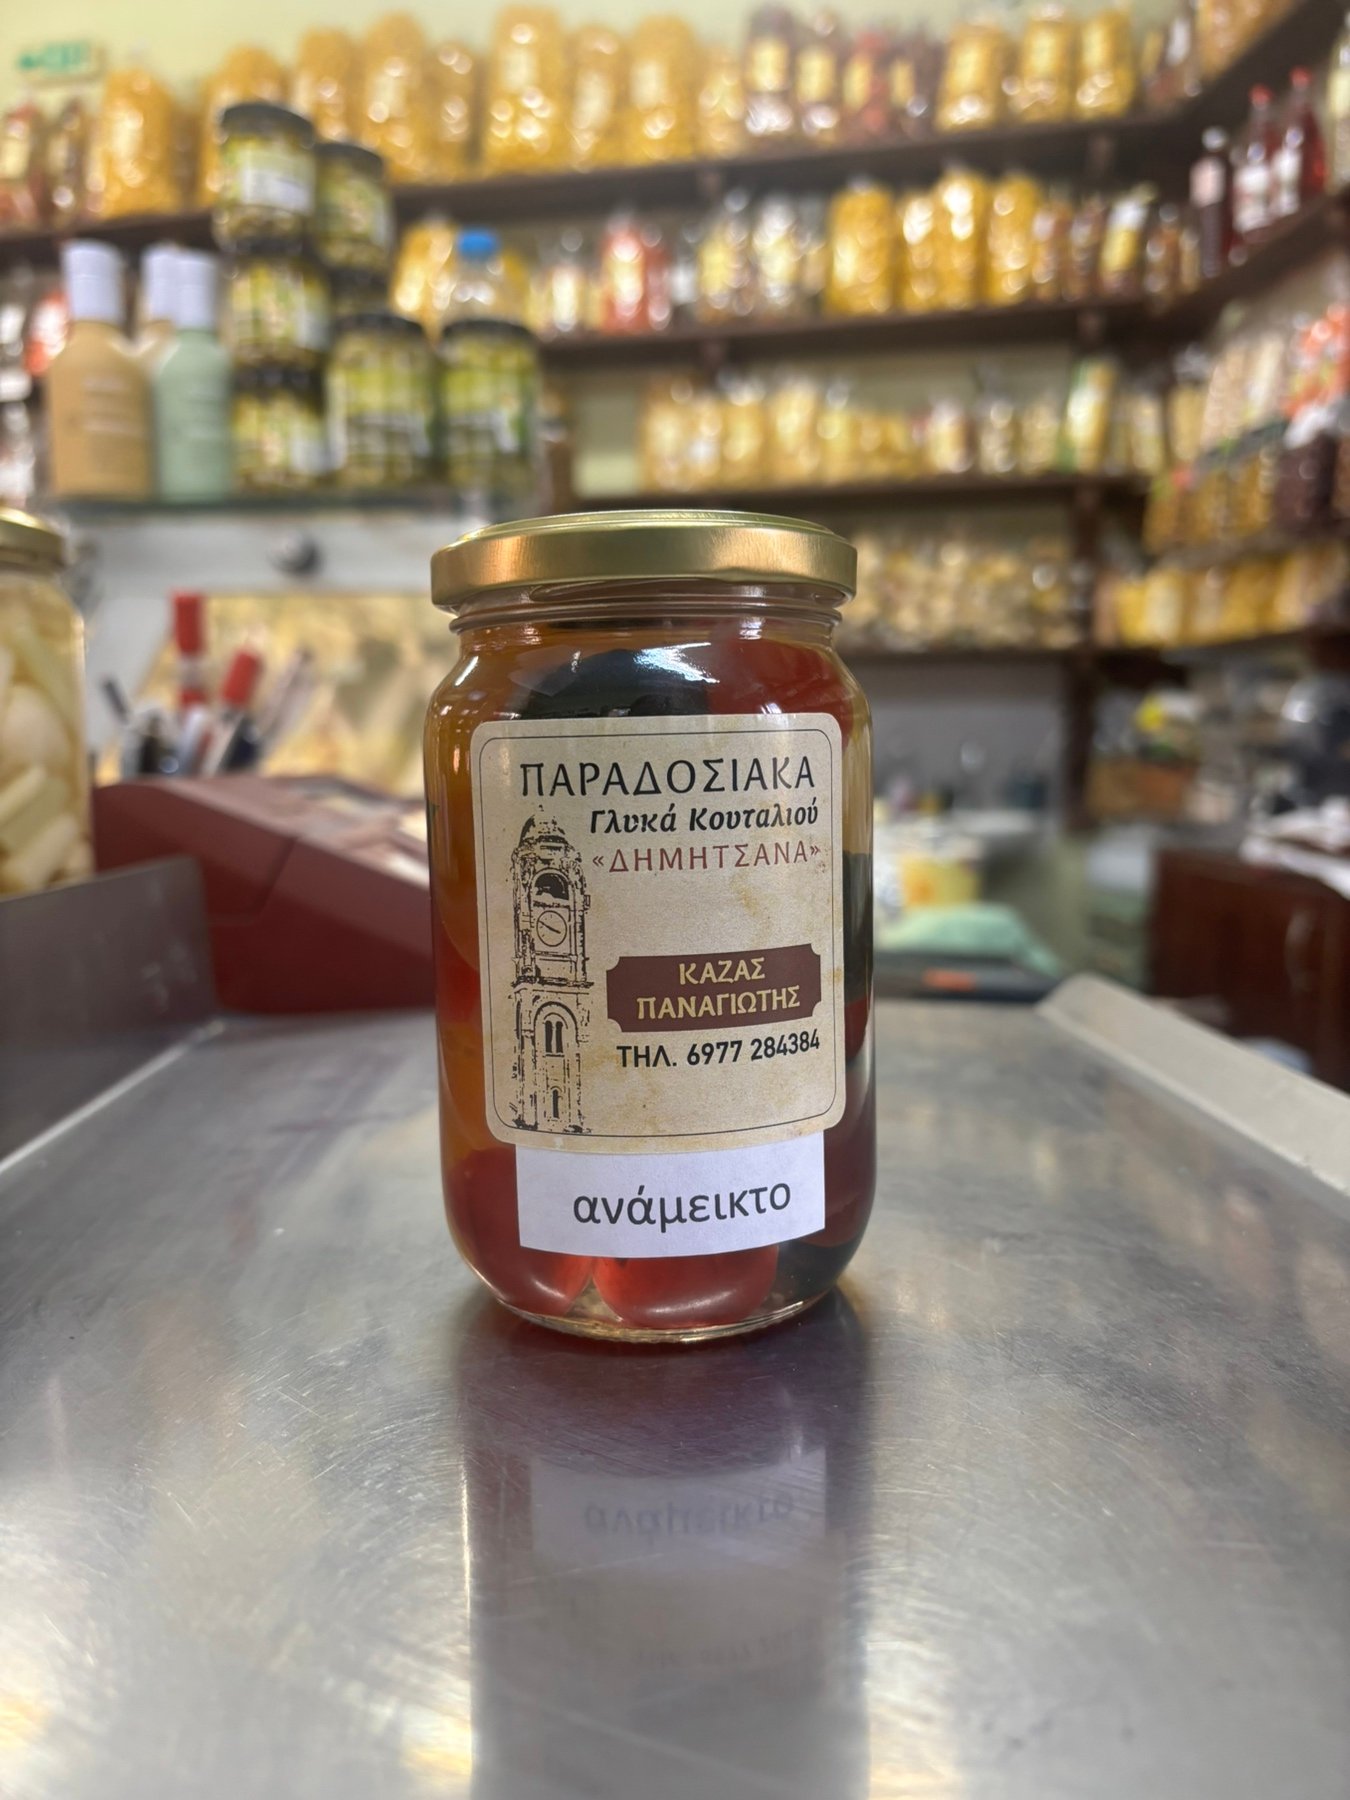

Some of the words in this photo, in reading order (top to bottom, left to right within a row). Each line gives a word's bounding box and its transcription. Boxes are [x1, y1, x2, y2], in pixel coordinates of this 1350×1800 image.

[520, 756, 815, 796] ΠΑΡΑΔΟΣΙΑΚΑ
[590, 803, 677, 834] Γλυκά
[689, 797, 819, 832] Κουταλιού
[592, 840, 820, 873] «ΔΗΜΗΤΣΑΝΑ»
[679, 957, 766, 985] ΚΑΖΑΣ
[637, 985, 801, 1020] ΠΑΝΑΓΙΩΤΗΣ
[616, 1045, 678, 1068] ΤΗΛ.
[686, 1040, 743, 1066] 6977
[750, 1029, 820, 1061] 284384
[573, 1182, 791, 1233] ανάμεικτο
